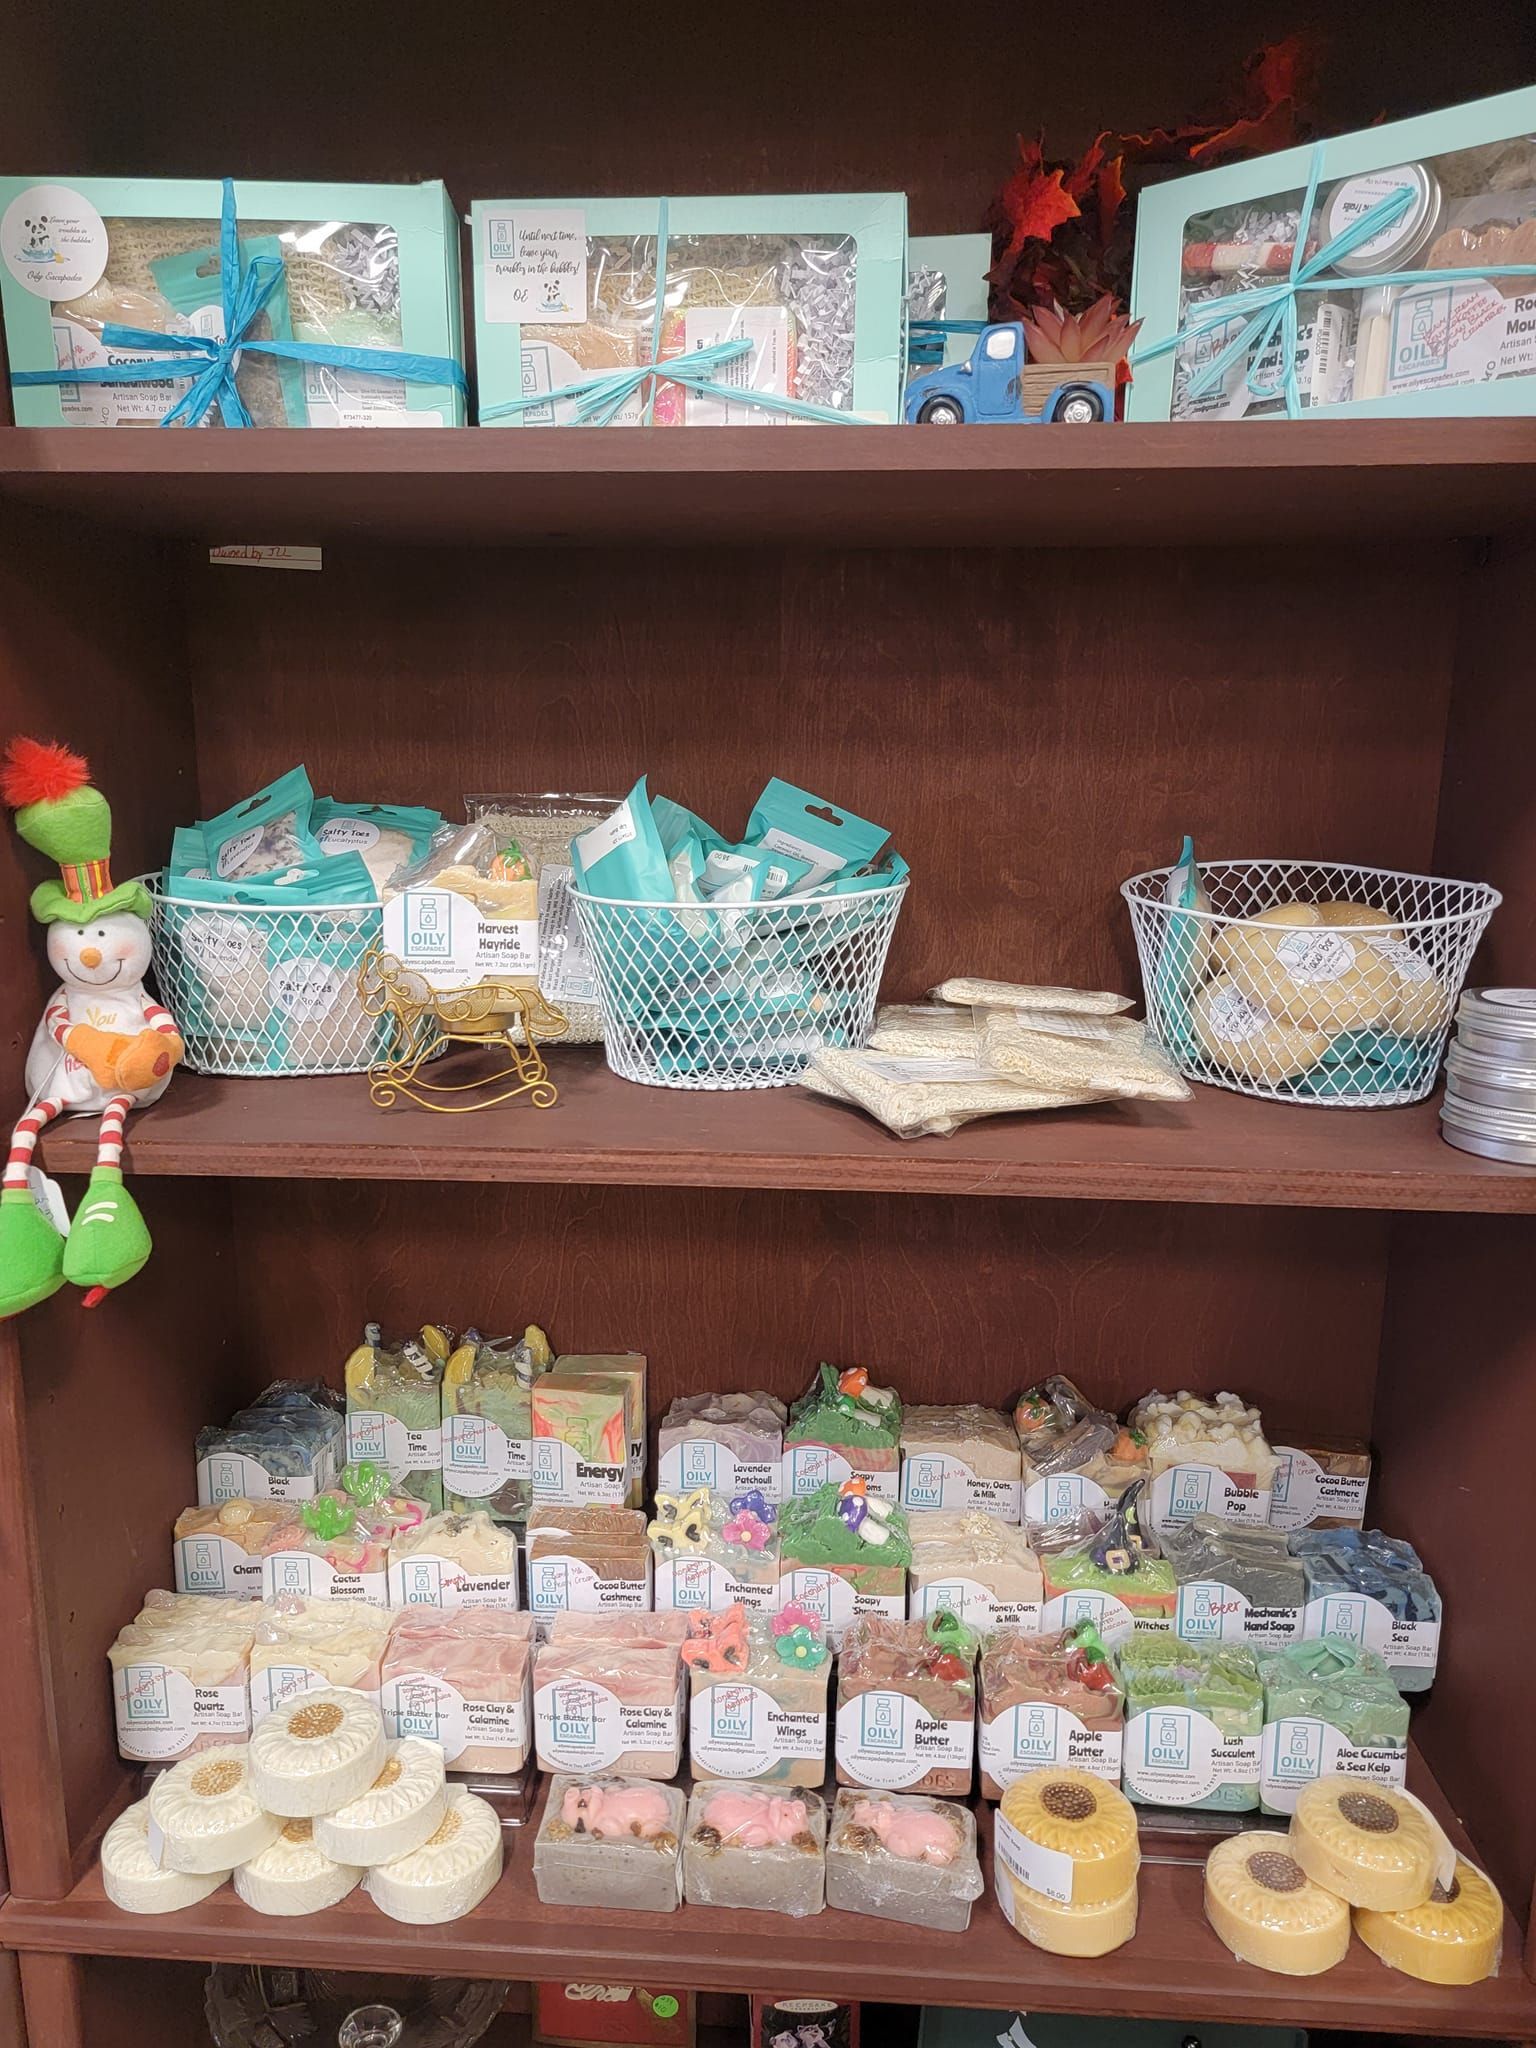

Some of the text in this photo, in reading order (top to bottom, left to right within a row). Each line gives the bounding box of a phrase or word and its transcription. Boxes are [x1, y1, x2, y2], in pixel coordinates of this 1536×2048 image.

[519, 229, 577, 242] Until next time,
[493, 244, 512, 252] OILY
[520, 246, 538, 258] leave
[527, 265, 536, 274] in
[1500, 337, 1532, 351] Artisan
[1500, 356, 1516, 366] Net
[112, 393, 138, 401] Artisan
[139, 393, 158, 401] Soap
[116, 404, 129, 412] Net
[251, 547, 263, 563] by
[240, 832, 256, 845] Toes
[322, 828, 370, 838] Salty Toes
[477, 922, 519, 935] Harvest
[411, 932, 446, 946] OILY
[479, 938, 521, 951] Hayride
[476, 951, 532, 960] Artisan Soap Bar
[86, 1007, 119, 1028] You
[406, 1432, 423, 1441] Tea
[408, 1443, 428, 1452] Time
[506, 1440, 522, 1449] Tea
[508, 1451, 527, 1461] Time
[576, 1462, 625, 1482] Energy
[733, 1464, 772, 1473] Lavender
[268, 1476, 291, 1486] Black
[686, 1471, 712, 1481] OILY
[735, 1475, 773, 1486] Patchouli
[1315, 1474, 1366, 1487] Cocoa Butter
[967, 1479, 1013, 1492] Honey, Oats,
[270, 1488, 286, 1496] Sea
[911, 1488, 938, 1499] OILY
[981, 1490, 997, 1499] Milk
[1224, 1487, 1260, 1499] Bubble
[1319, 1486, 1360, 1498] Cashmere
[1226, 1500, 1247, 1512] Pop
[191, 1571, 220, 1582] OILY
[332, 1574, 361, 1584] Cactus
[330, 1585, 366, 1596] Blossom
[456, 1579, 511, 1593] Lavender
[593, 1581, 647, 1591] Cocoa Butter
[724, 1582, 773, 1595] Enchanted
[408, 1592, 438, 1603] OILY
[536, 1593, 564, 1604] OILY
[600, 1592, 642, 1603] Cashmere
[678, 1589, 707, 1601] OILY
[733, 1595, 762, 1608] Wings
[854, 1596, 881, 1607] Soapy
[988, 1603, 1038, 1614] Honey, Oats,
[1210, 1600, 1241, 1616] Beer
[1244, 1607, 1298, 1619] Mechanic's
[995, 1613, 1021, 1624] & Milk
[1186, 1618, 1217, 1630] OILY
[1134, 1620, 1171, 1631] Witches
[1244, 1621, 1296, 1633] Hand Soap
[1391, 1621, 1417, 1632] Black
[1392, 1633, 1410, 1643] Sea
[195, 1688, 220, 1698] Rose
[133, 1698, 163, 1710] OILY
[193, 1702, 225, 1712] Quartz
[463, 1703, 515, 1715] Rose Clay &
[382, 1708, 450, 1720] Triple Butter Bar
[539, 1713, 607, 1723] Triple Butter Bar
[619, 1707, 673, 1719] Rose Clay &
[767, 1711, 820, 1724] Enchanted
[403, 1718, 433, 1730] OILY
[468, 1715, 510, 1726] Calamine
[625, 1719, 668, 1730] Calamine
[717, 1719, 747, 1731] OILY
[914, 1719, 949, 1732] Apple
[466, 1725, 515, 1734] Artisan Soap Bar
[560, 1722, 589, 1734] OILY
[776, 1725, 807, 1738] Wings
[867, 1727, 898, 1739] OILY
[645, 1730, 662, 1738] Soap
[1069, 1730, 1103, 1743] Apple
[914, 1733, 951, 1747] Butter
[1020, 1738, 1053, 1751] OILY
[1223, 1736, 1244, 1746] Lush
[1068, 1744, 1104, 1758] Butter
[1151, 1747, 1185, 1759] OILY
[1210, 1748, 1256, 1759] Succulent
[1336, 1749, 1360, 1759] Aloe
[1281, 1756, 1315, 1769] OILY
[1335, 1761, 1392, 1774] & Sea Kelp
